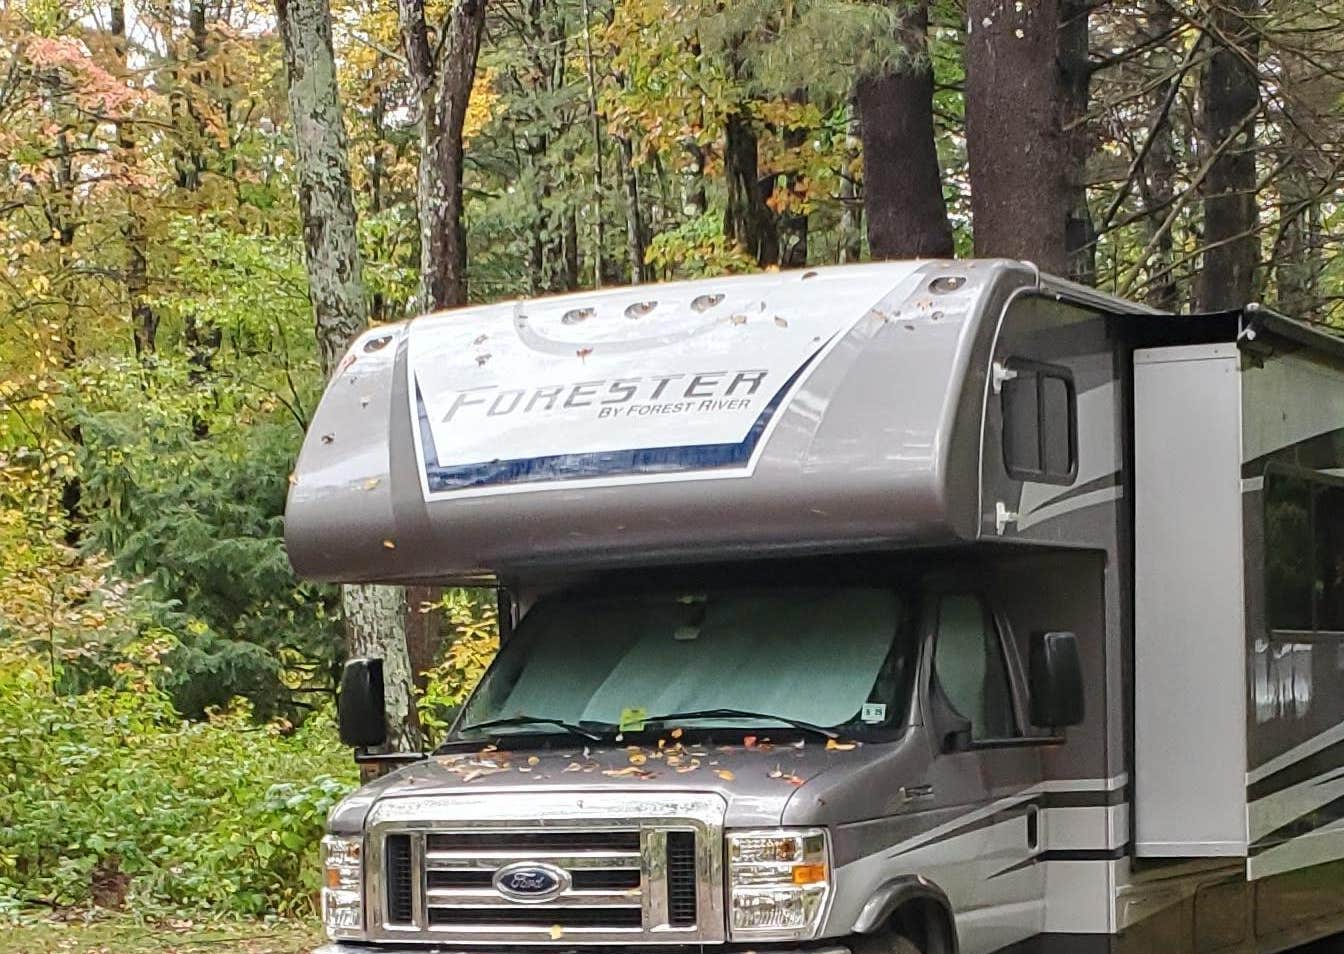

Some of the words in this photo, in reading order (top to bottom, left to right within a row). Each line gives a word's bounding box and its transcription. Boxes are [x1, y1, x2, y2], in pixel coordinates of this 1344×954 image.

[443, 369, 769, 423] FORESTER
[598, 405, 623, 418] BY
[626, 402, 695, 416] FOREST
[698, 398, 751, 411] RIVER
[510, 872, 545, 889] Ford
